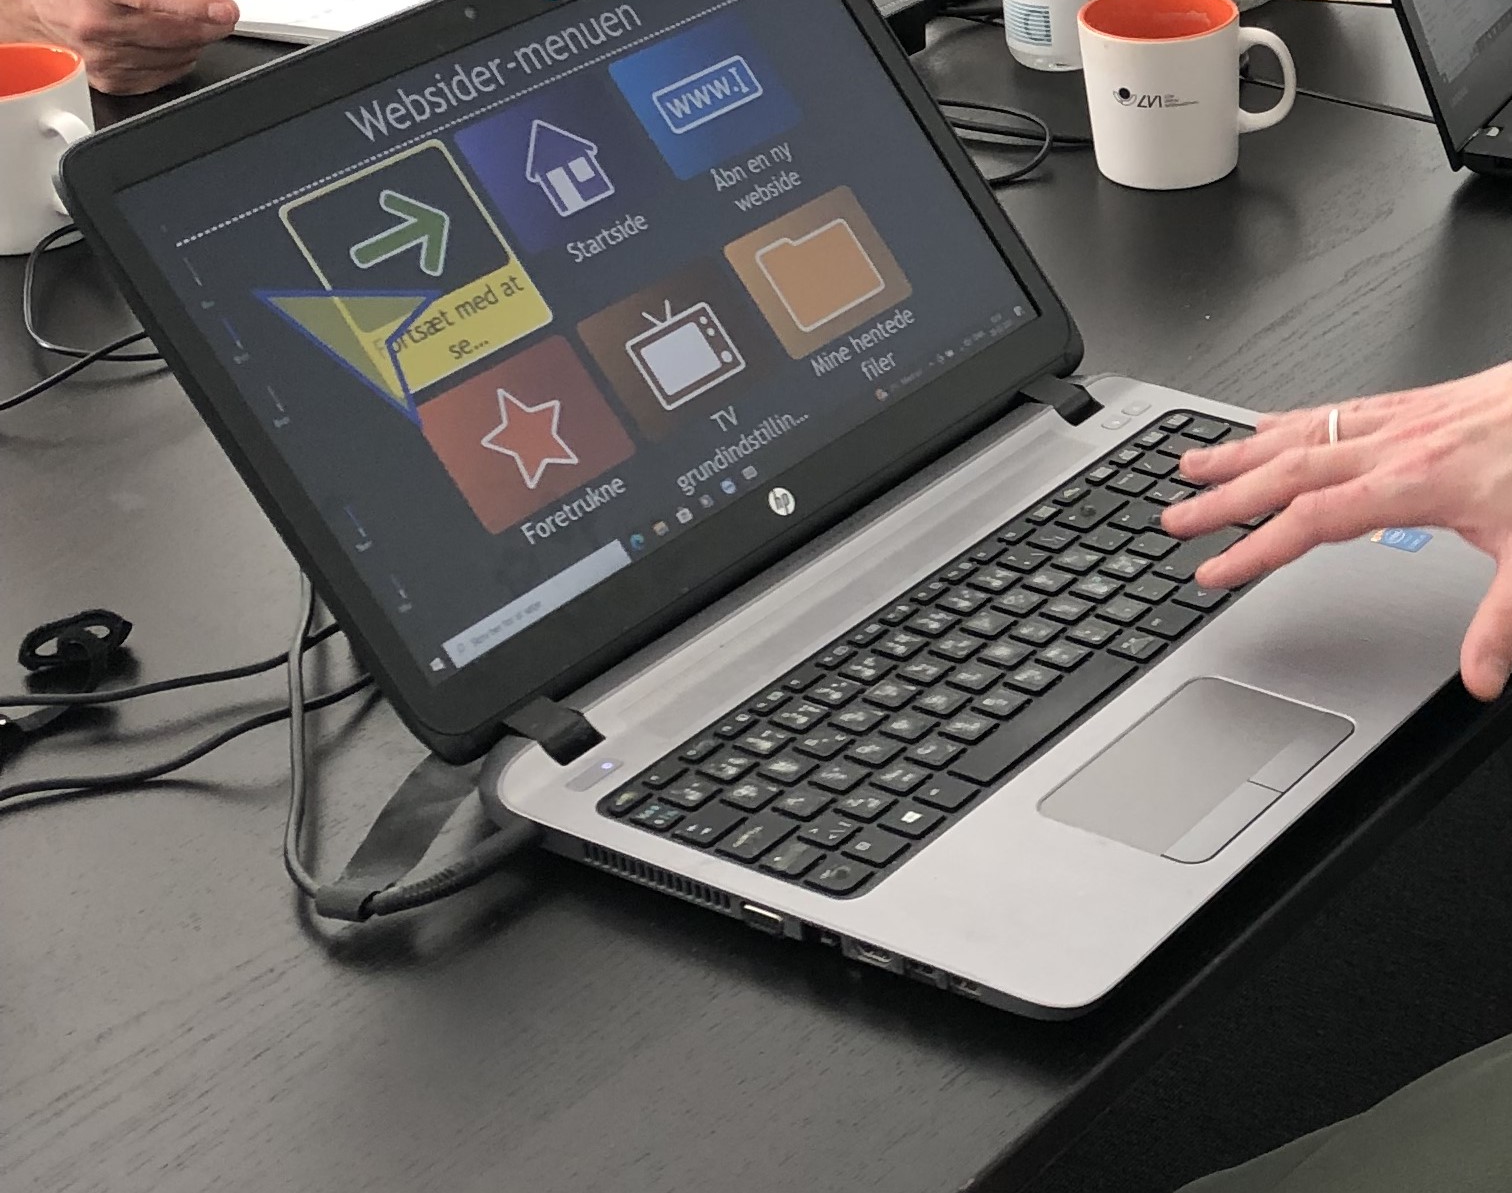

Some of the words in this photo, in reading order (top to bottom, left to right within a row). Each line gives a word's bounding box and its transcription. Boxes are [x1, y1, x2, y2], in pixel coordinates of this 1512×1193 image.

[344, 3, 642, 142] Websider-menuen
[710, 163, 747, 191] Åbn
[747, 154, 770, 174] en
[770, 142, 793, 162] ny
[735, 171, 801, 211] webside
[566, 214, 649, 263] Startside
[455, 284, 498, 320] med
[500, 275, 524, 298] at
[810, 346, 852, 377] Mine
[849, 308, 916, 354] hentede
[860, 351, 896, 381] filer
[710, 406, 740, 432] TV
[520, 477, 627, 545] Foretrukne
